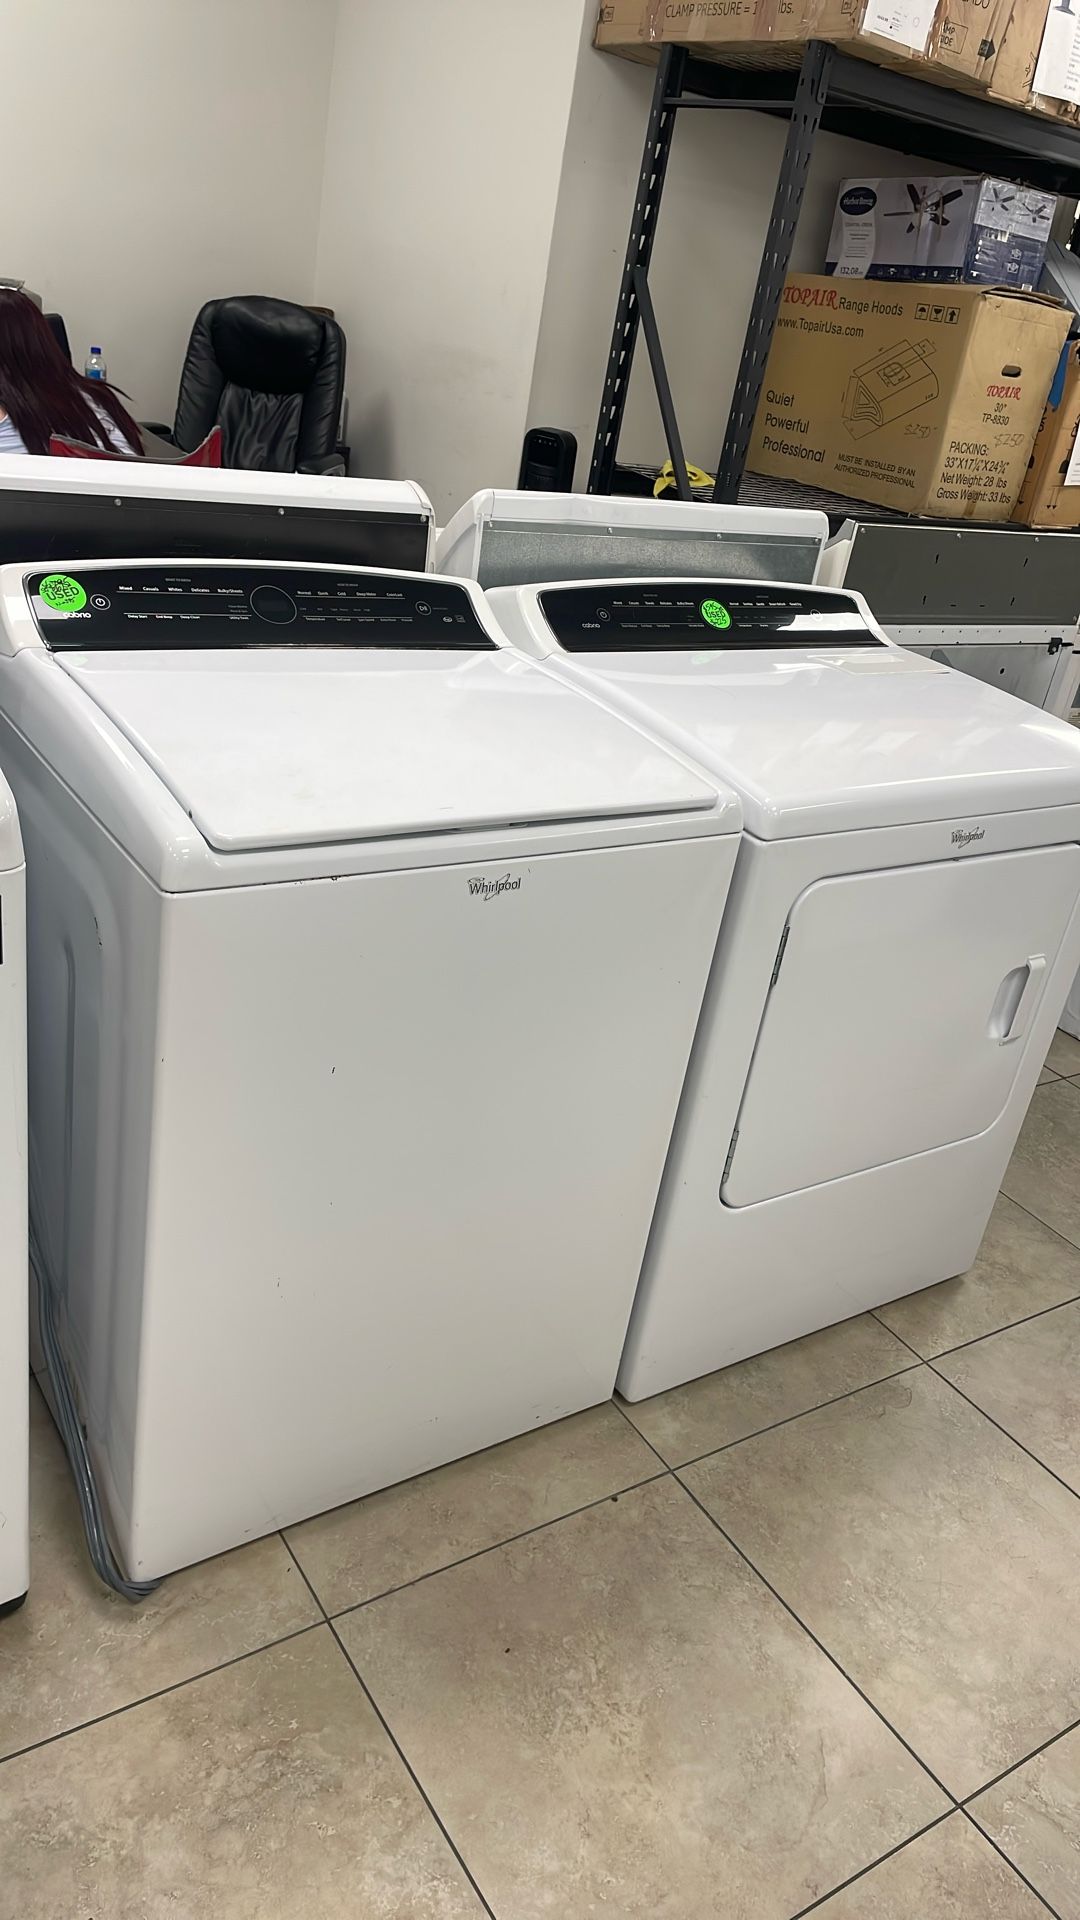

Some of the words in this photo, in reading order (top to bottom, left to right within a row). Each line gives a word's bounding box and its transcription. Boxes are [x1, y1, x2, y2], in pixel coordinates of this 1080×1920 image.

[665, 4, 695, 18] CLAMP
[696, 1, 741, 17] PRESSURE
[783, 286, 838, 310] TOPAIR
[838, 297, 869, 314] Range
[871, 300, 904, 316] Hoods
[777, 318, 864, 337] www.TopairUsa.com
[766, 390, 795, 407] Quiet
[986, 385, 1021, 400] TOPAIR
[764, 412, 810, 434] Powerful
[762, 436, 826, 463] Professional
[949, 441, 990, 456] PACKING:
[838, 453, 855, 463] MUST
[854, 456, 863, 465] BE
[864, 459, 895, 472] INSTALLED
[833, 463, 870, 477] AUTHORIZED
[869, 469, 916, 489] PROFESSIONAL
[940, 472, 954, 484] Net
[955, 473, 983, 488] Weight:
[983, 476, 995, 487] 28
[996, 477, 1008, 489] lbs
[936, 487, 959, 500] Gross
[960, 489, 987, 504] Weight:
[988, 491, 999, 503] 33
[999, 492, 1012, 504] lbs
[46, 586, 80, 601] USED
[950, 829, 985, 846] Whirlpool
[468, 874, 522, 898] Whirlpool
